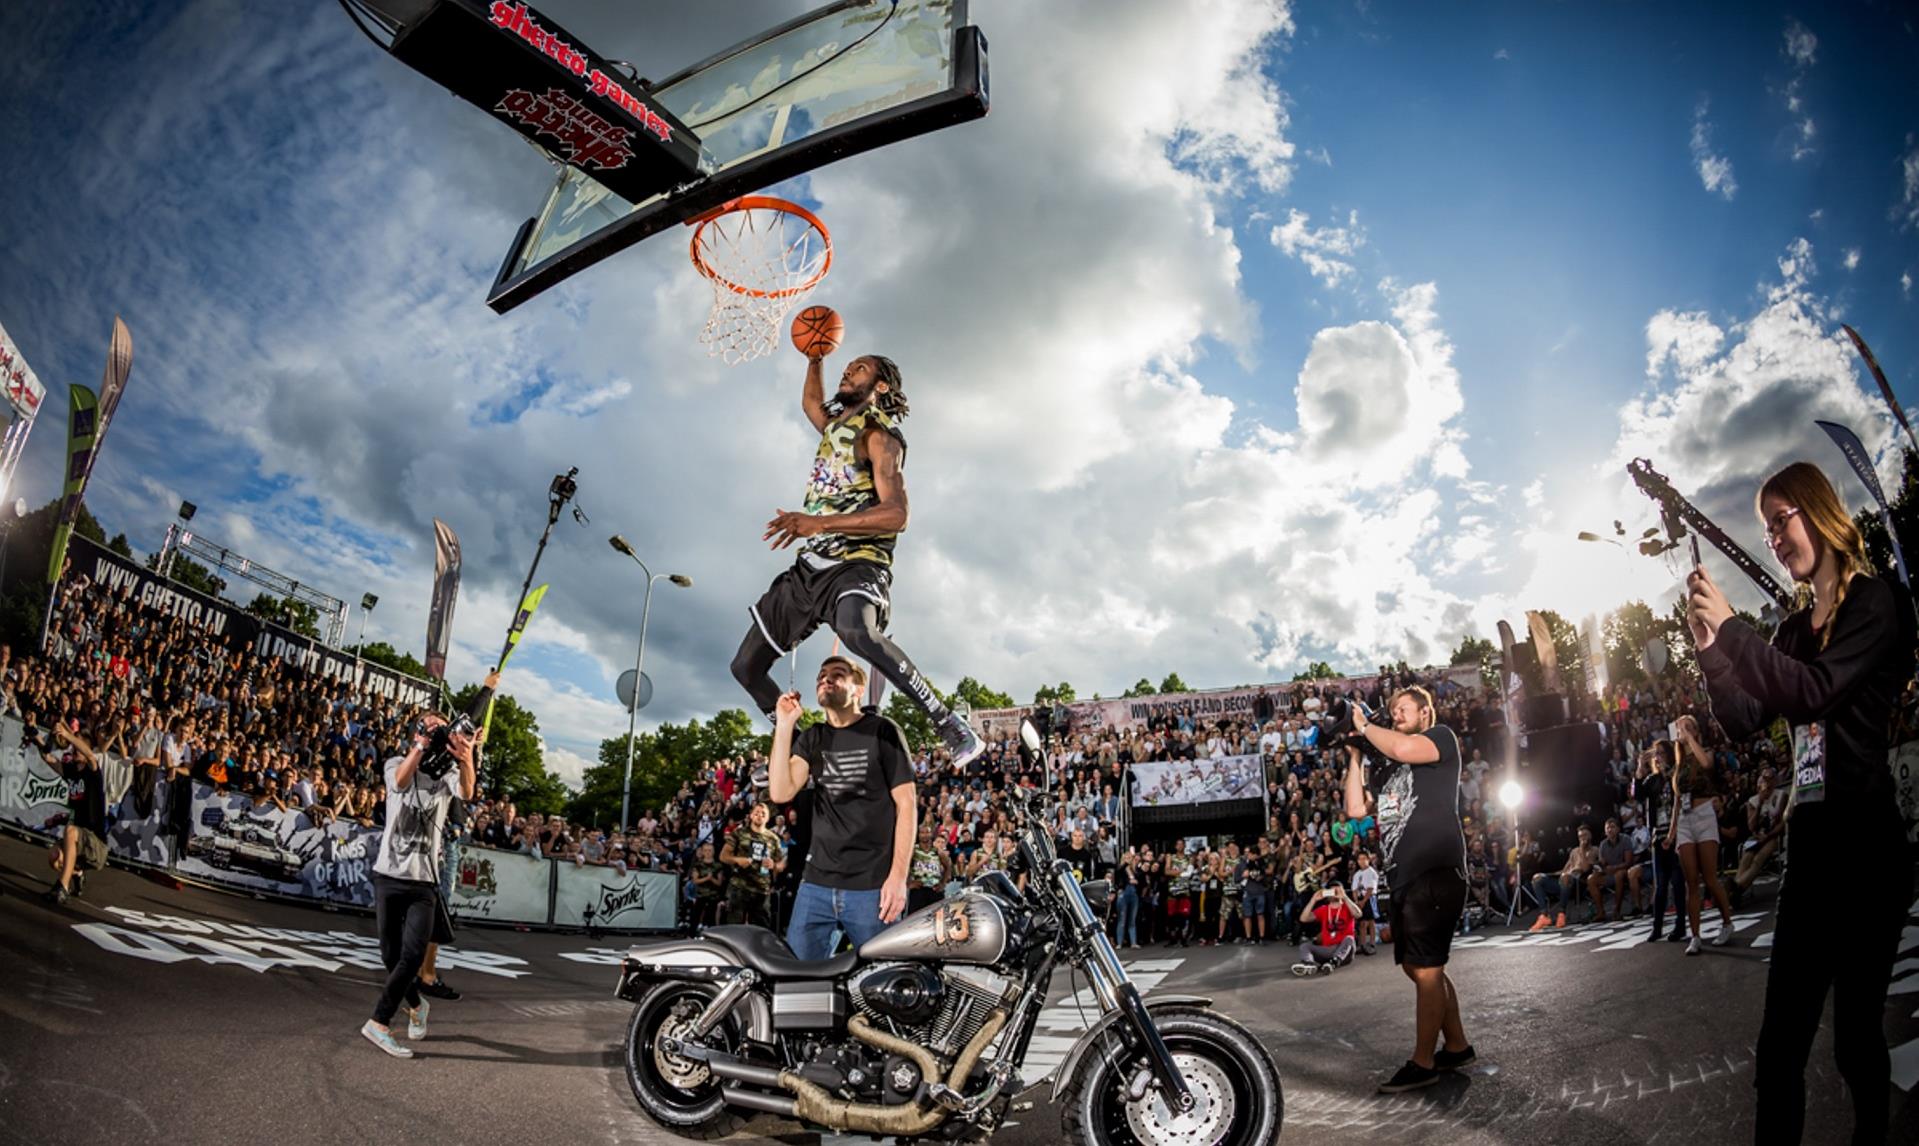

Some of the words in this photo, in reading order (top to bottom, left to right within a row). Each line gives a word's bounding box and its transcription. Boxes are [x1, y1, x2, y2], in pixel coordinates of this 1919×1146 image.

[488, 0, 588, 77] ghetto
[586, 69, 676, 143] games
[24, 778, 68, 803] Sprite
[1797, 764, 1825, 787] MEDIA
[314, 862, 335, 882] OF
[337, 858, 368, 887] AIR
[600, 885, 641, 917] Sprite
[934, 899, 970, 945] 13
